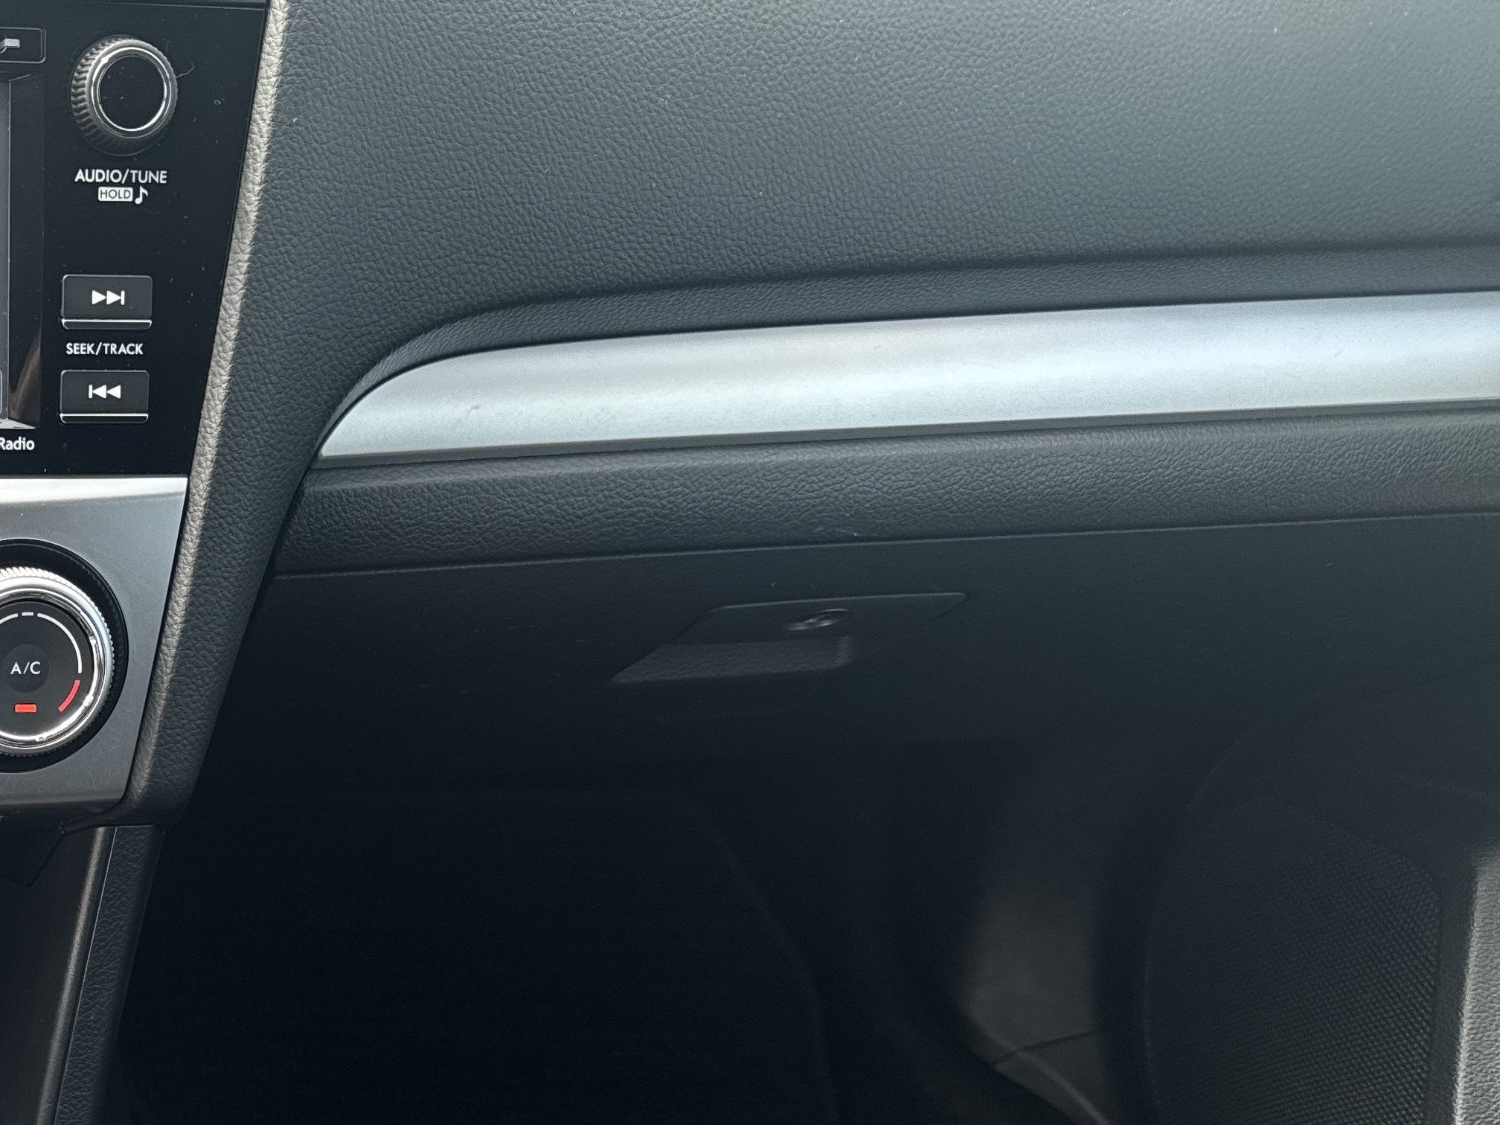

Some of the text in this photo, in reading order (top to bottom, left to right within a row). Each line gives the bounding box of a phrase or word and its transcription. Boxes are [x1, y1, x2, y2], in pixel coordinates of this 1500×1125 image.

[74, 168, 168, 184] AUDIO/TUNE
[99, 188, 132, 200] HOLD
[65, 342, 144, 357] SEEK/TRACK
[10, 661, 41, 675] A/C
